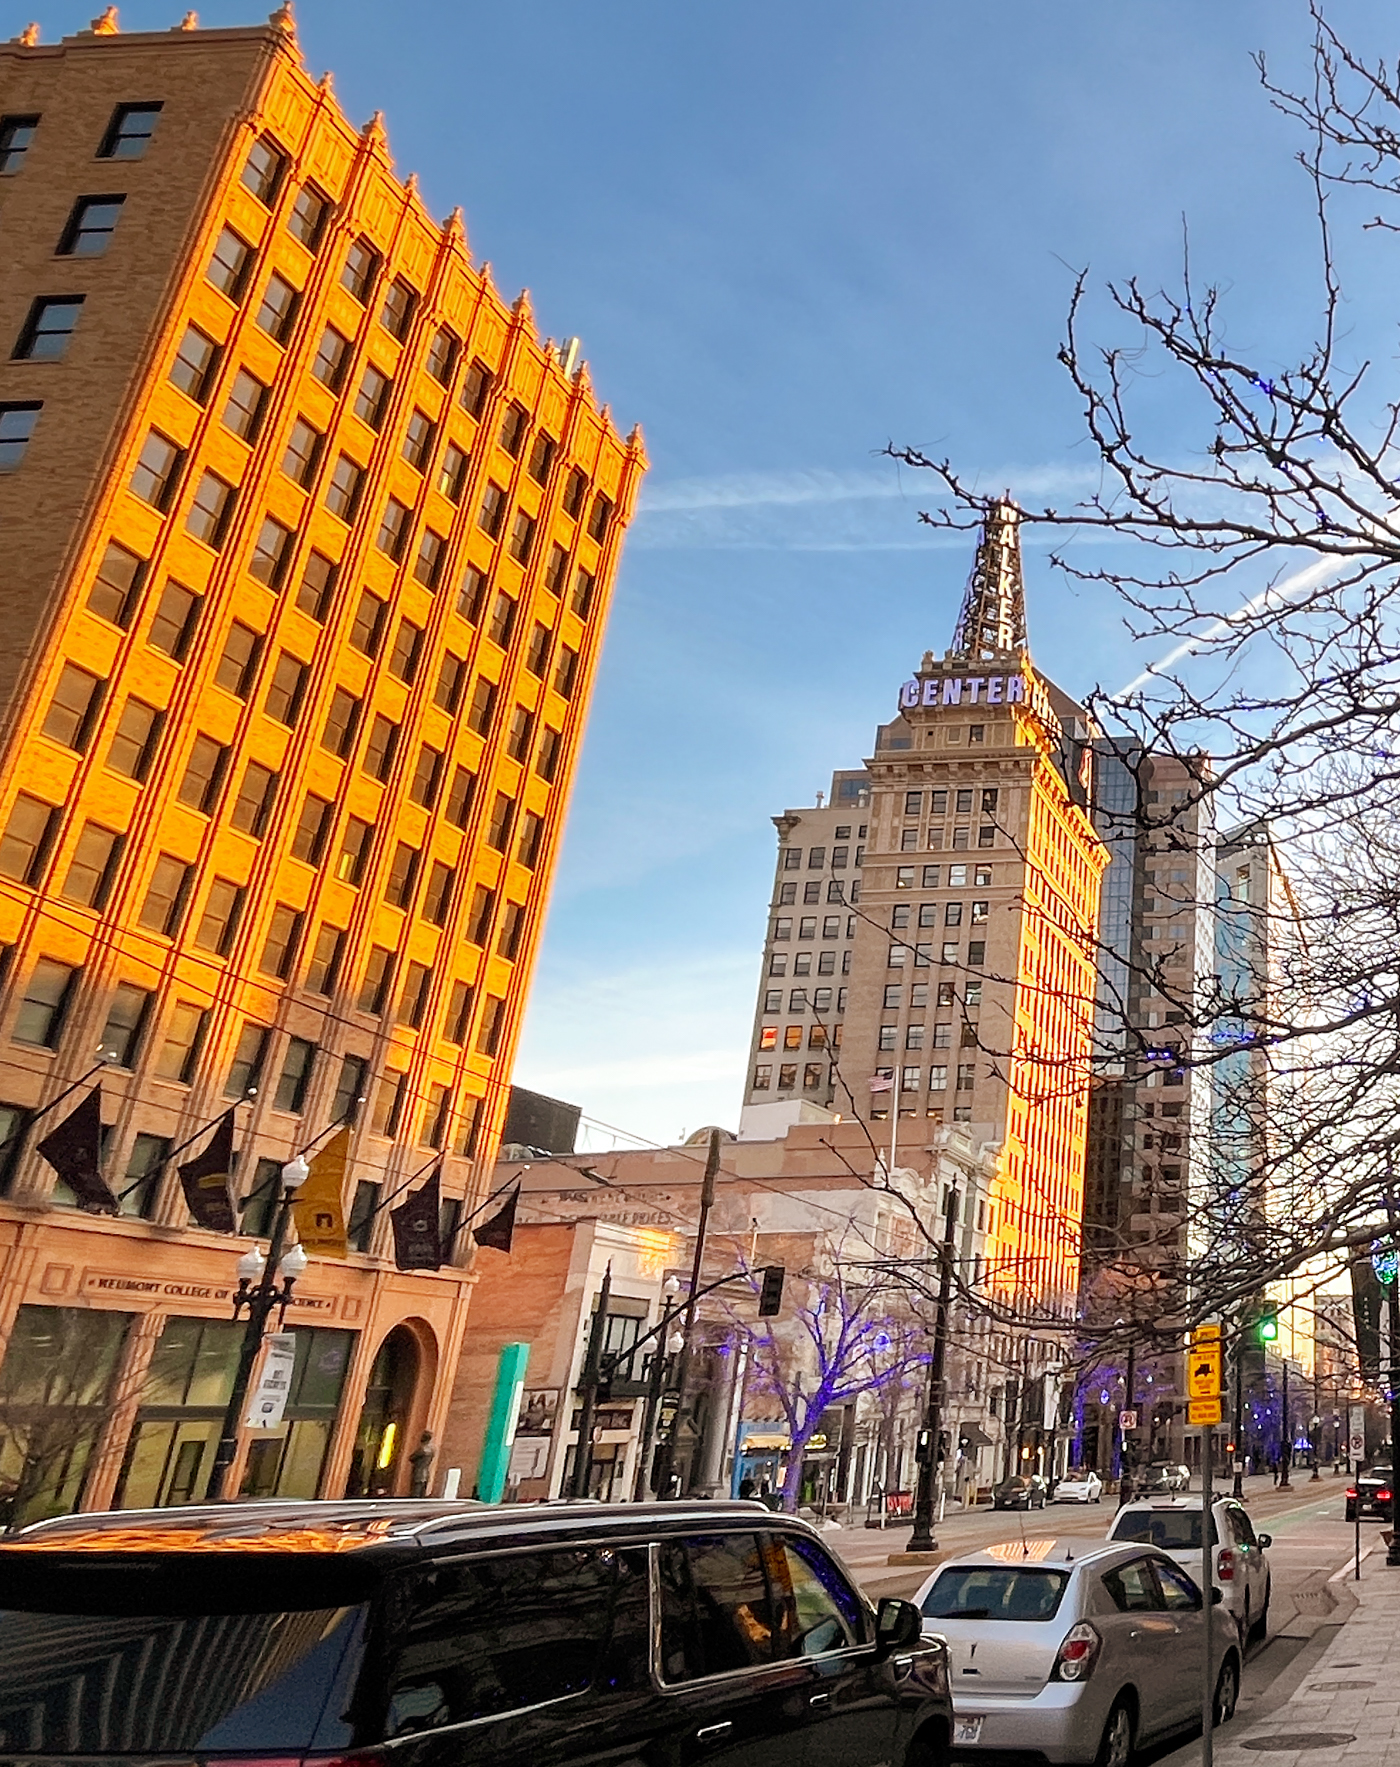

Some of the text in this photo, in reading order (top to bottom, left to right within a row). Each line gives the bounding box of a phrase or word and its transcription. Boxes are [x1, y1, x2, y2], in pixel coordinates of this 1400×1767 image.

[998, 498, 1018, 652] WALKER
[901, 675, 1024, 708] CENTER
[164, 1284, 213, 1298] COLLEGE
